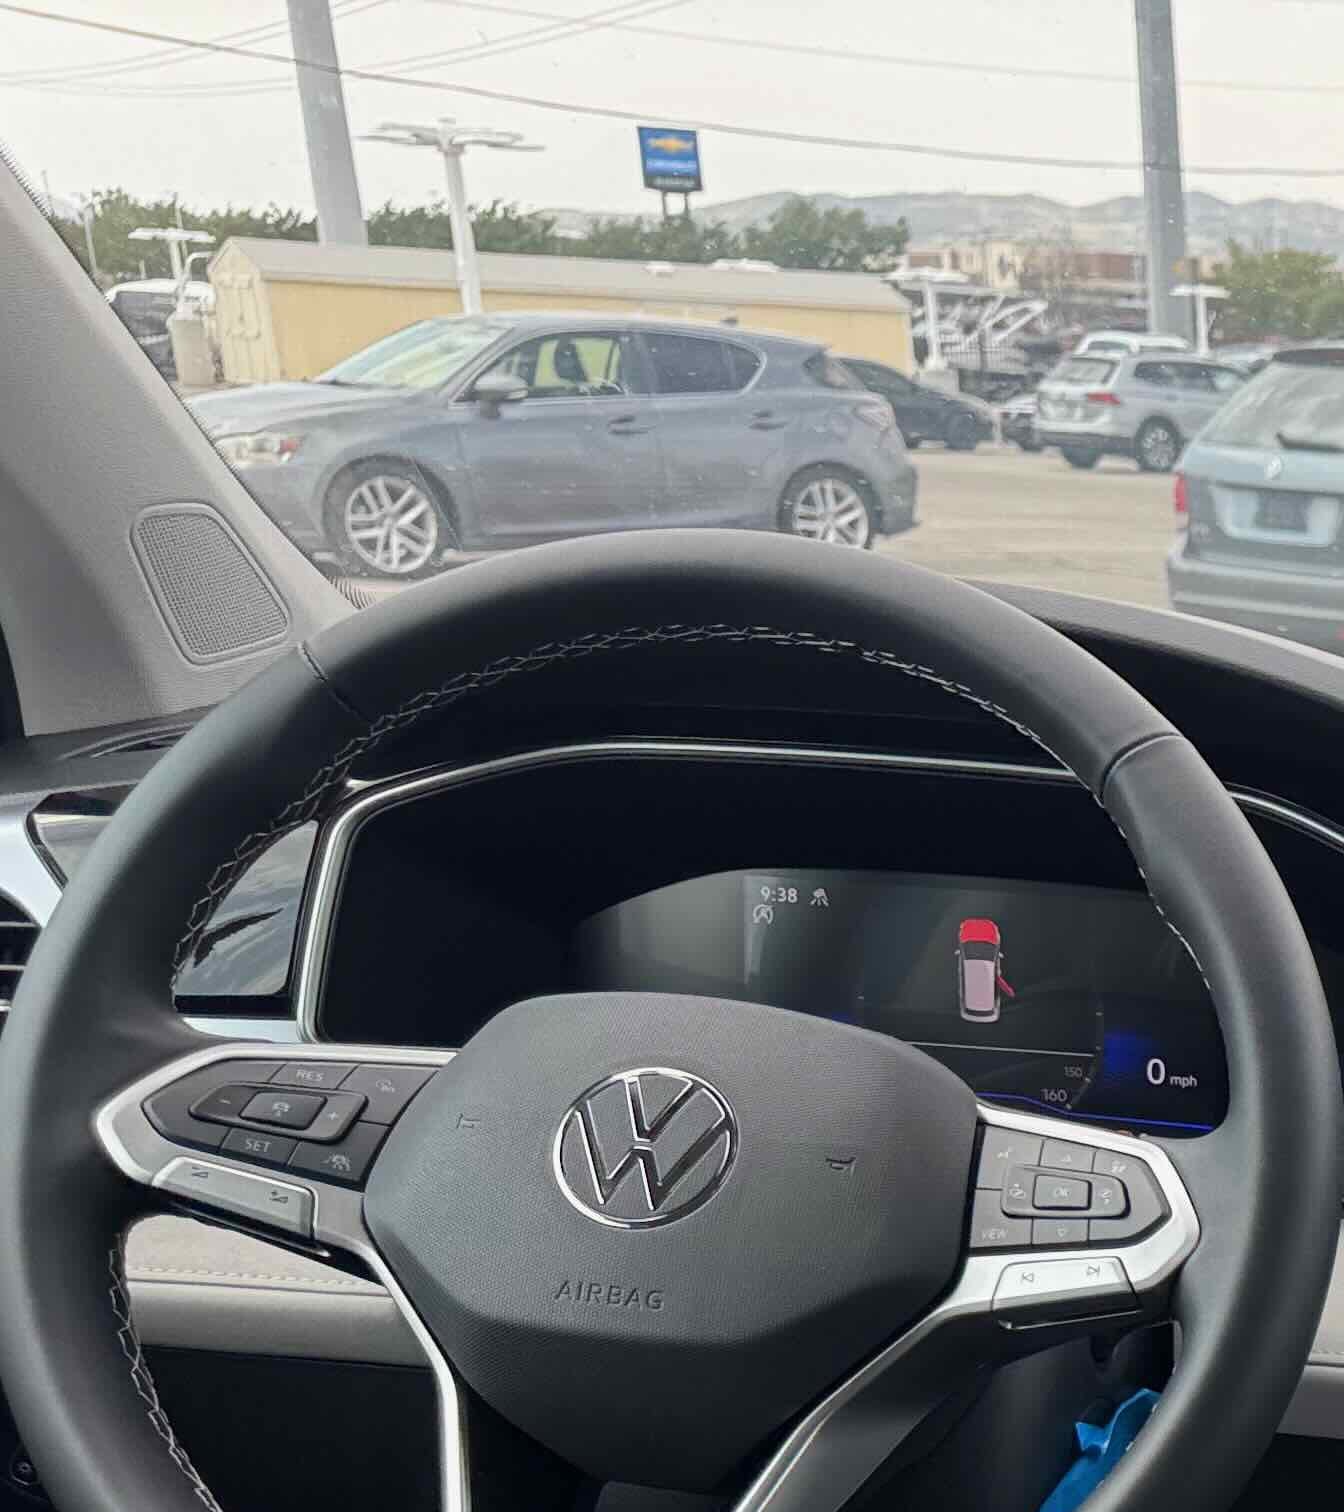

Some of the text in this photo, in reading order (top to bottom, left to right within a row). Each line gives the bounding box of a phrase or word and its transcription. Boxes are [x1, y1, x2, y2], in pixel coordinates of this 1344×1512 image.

[760, 886, 798, 903] 9:38
[295, 1069, 325, 1082] RES
[1063, 1066, 1083, 1078] 150
[1146, 1058, 1198, 1089] 0 mph
[1041, 1088, 1068, 1102] 160
[244, 1139, 272, 1153] SET
[555, 1279, 665, 1312] AIRBAG
